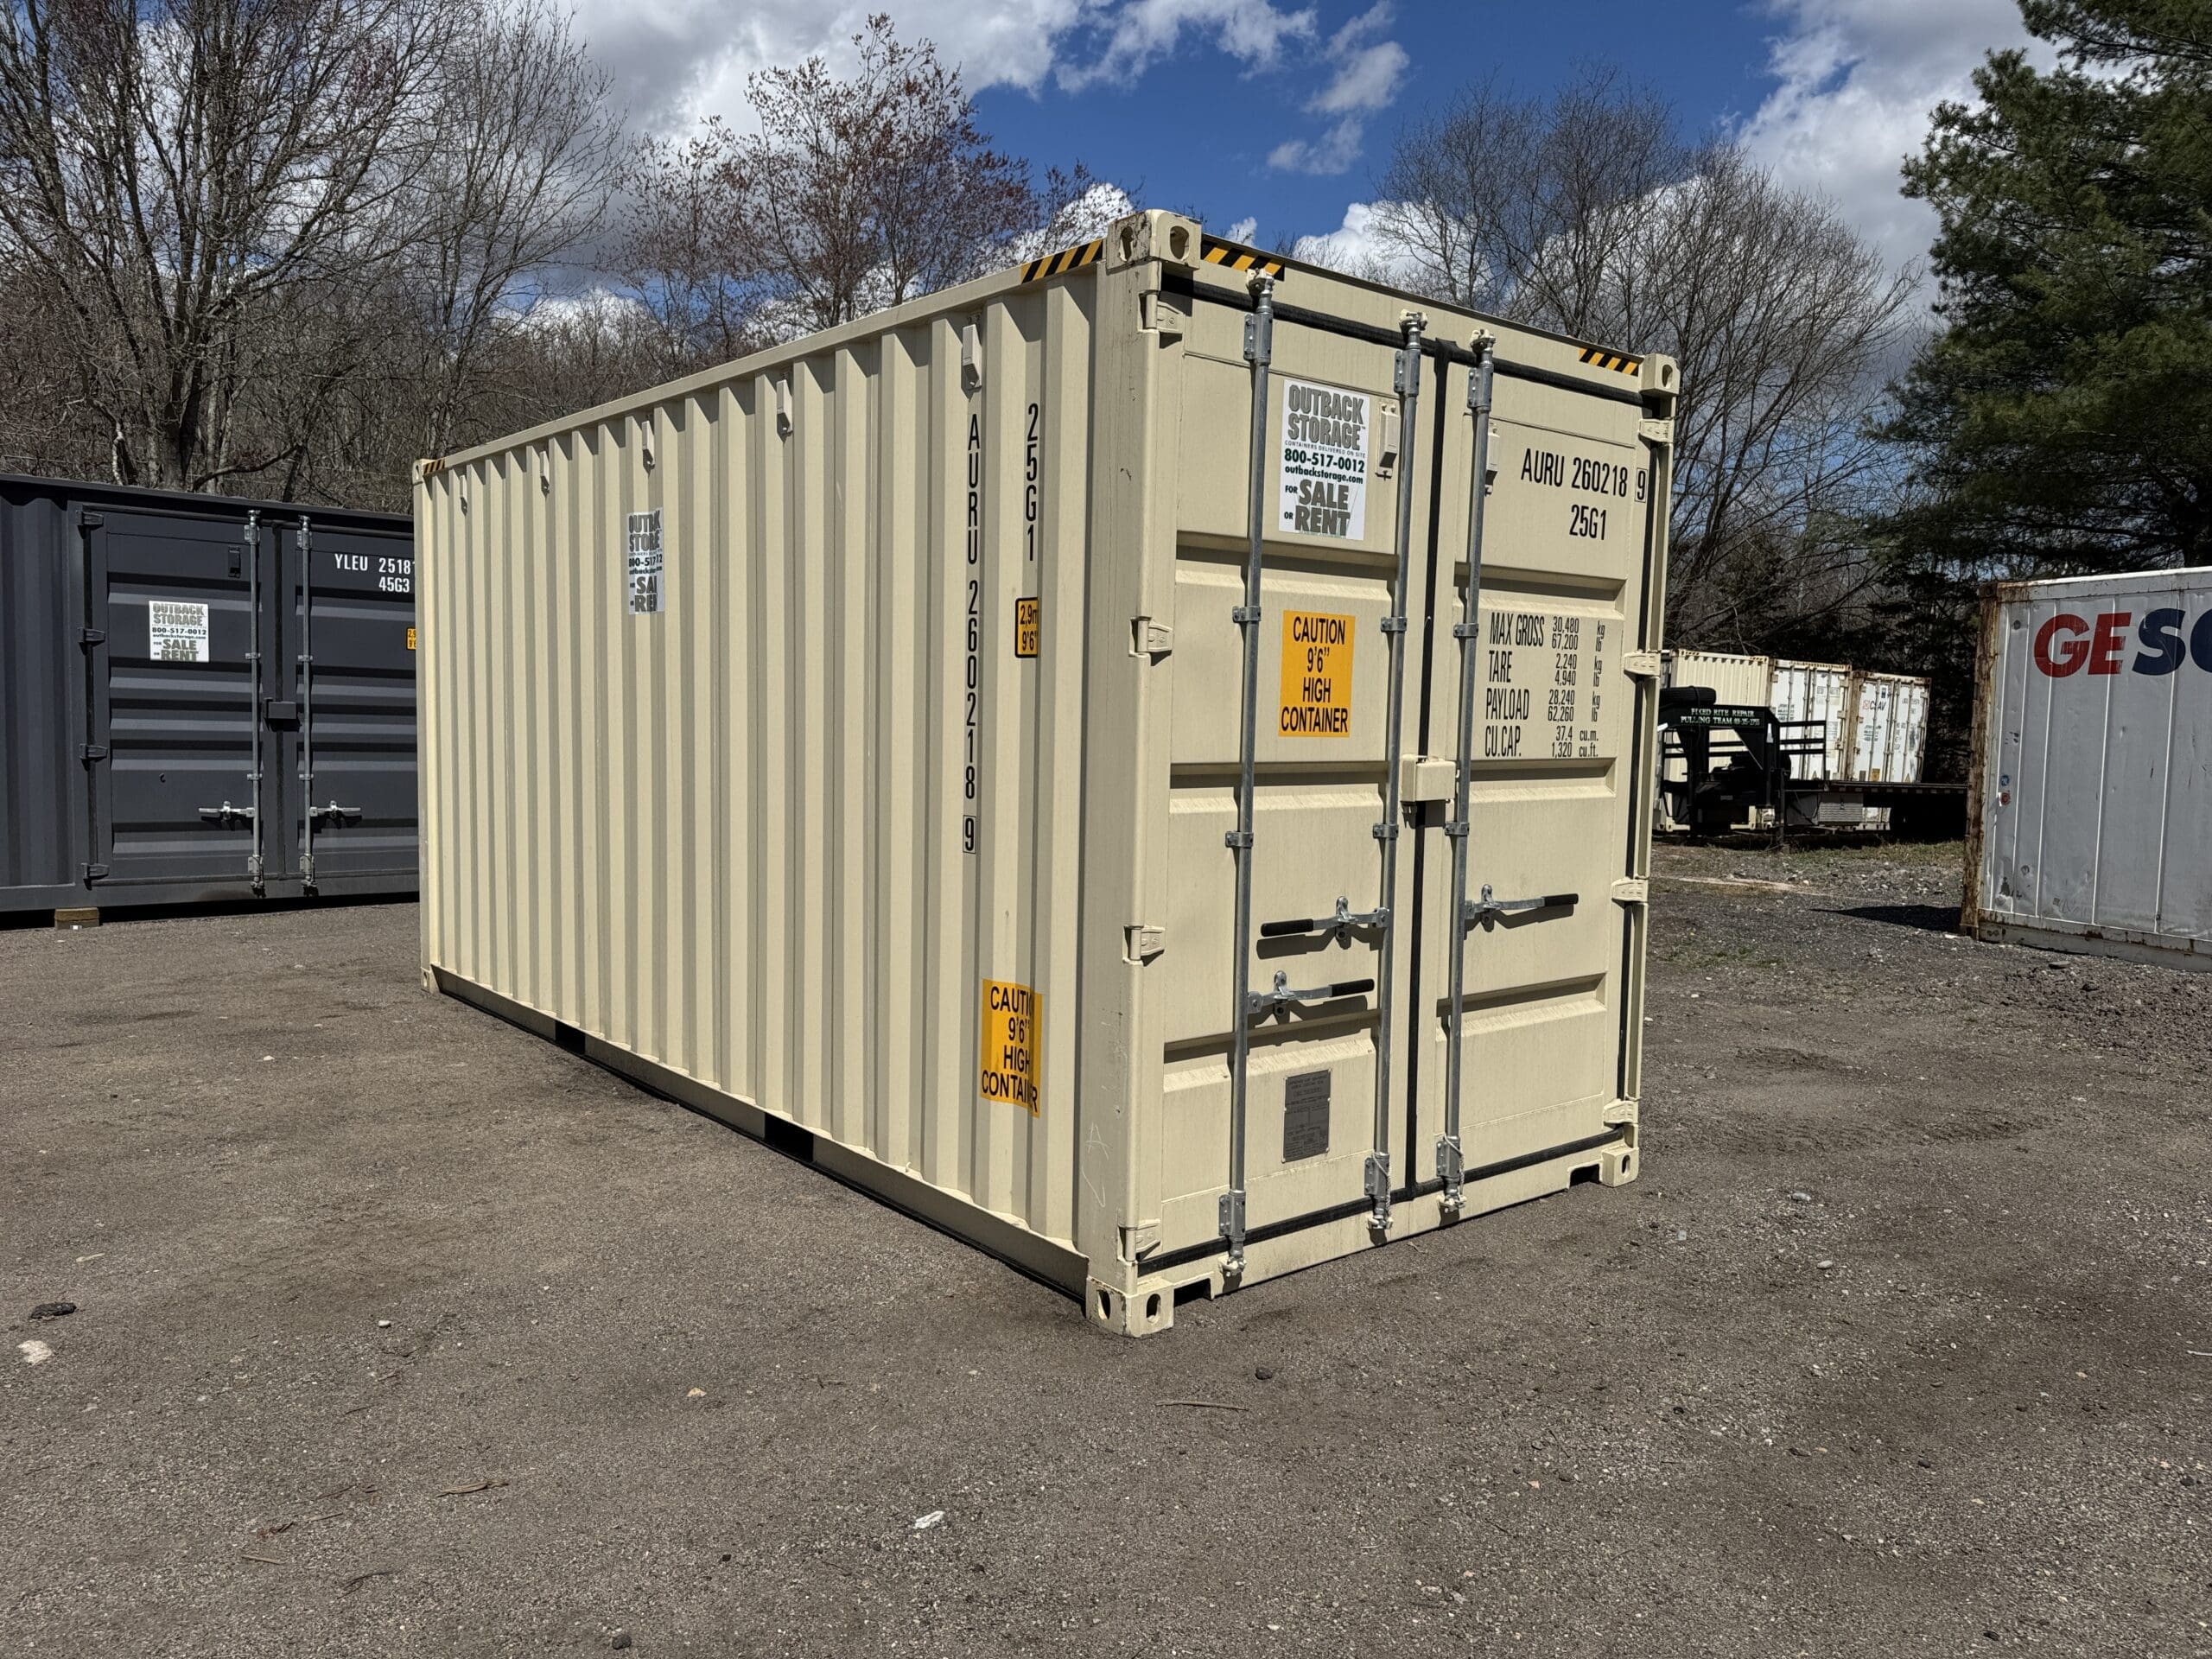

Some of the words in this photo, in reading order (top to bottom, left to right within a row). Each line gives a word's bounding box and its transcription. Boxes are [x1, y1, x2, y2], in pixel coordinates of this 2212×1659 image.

[1288, 385, 1364, 424] OUTBACK
[1287, 413, 1361, 450] STORAGE
[1285, 440, 1317, 449] CONTAINERS
[1319, 446, 1345, 454] DELIVERED
[1284, 448, 1365, 474] 800-517-0012
[1285, 465, 1363, 484] outbackstorage.com
[1521, 448, 1565, 486] AURU
[1571, 456, 1628, 497] 260218
[1637, 470, 1646, 500] 9
[968, 414, 980, 564] AURU
[1026, 403, 1039, 562] 25G1
[1285, 485, 1298, 494] FOR
[1299, 479, 1350, 511] SALE
[1284, 512, 1294, 520] OR
[1295, 505, 1351, 537] RENT
[1569, 504, 1607, 540] 25G1
[334, 553, 368, 571] YLEU
[378, 576, 410, 593] 45G3
[152, 602, 205, 615] OUTBACK
[153, 613, 203, 626] STORAGE
[1293, 616, 1346, 645] CAUTION
[1490, 612, 1514, 645] MAX
[1516, 614, 1545, 647] GROSS
[1552, 616, 1580, 633] 30,480
[1597, 620, 1605, 639] kg
[1551, 633, 1579, 651] 67,200
[1595, 636, 1602, 652] lb
[161, 649, 199, 662] RENT
[162, 639, 197, 651] SALE
[1307, 646, 1330, 673] 9'6"
[1489, 650, 1513, 683] TARE
[1555, 653, 1578, 670] 2,240
[1594, 656, 1603, 674] kg
[965, 580, 978, 799] 260218
[1302, 677, 1332, 703] HIGH
[1554, 670, 1576, 686] 4,940
[1593, 671, 1599, 687] lb
[1485, 688, 1529, 720] PAYLOAD
[1548, 689, 1575, 705] 28,240
[1592, 691, 1600, 709] kg
[1548, 706, 1574, 722] 62,260
[1592, 707, 1598, 722] lb
[1281, 706, 1349, 733] CONTAINER
[1485, 726, 1522, 757] CU.CAP.
[1555, 726, 1573, 741] 37.4
[1580, 730, 1599, 741] cu.m.
[1552, 742, 1573, 758] 1,320
[1579, 743, 1599, 757] cu.ft.
[964, 817, 975, 851] 9
